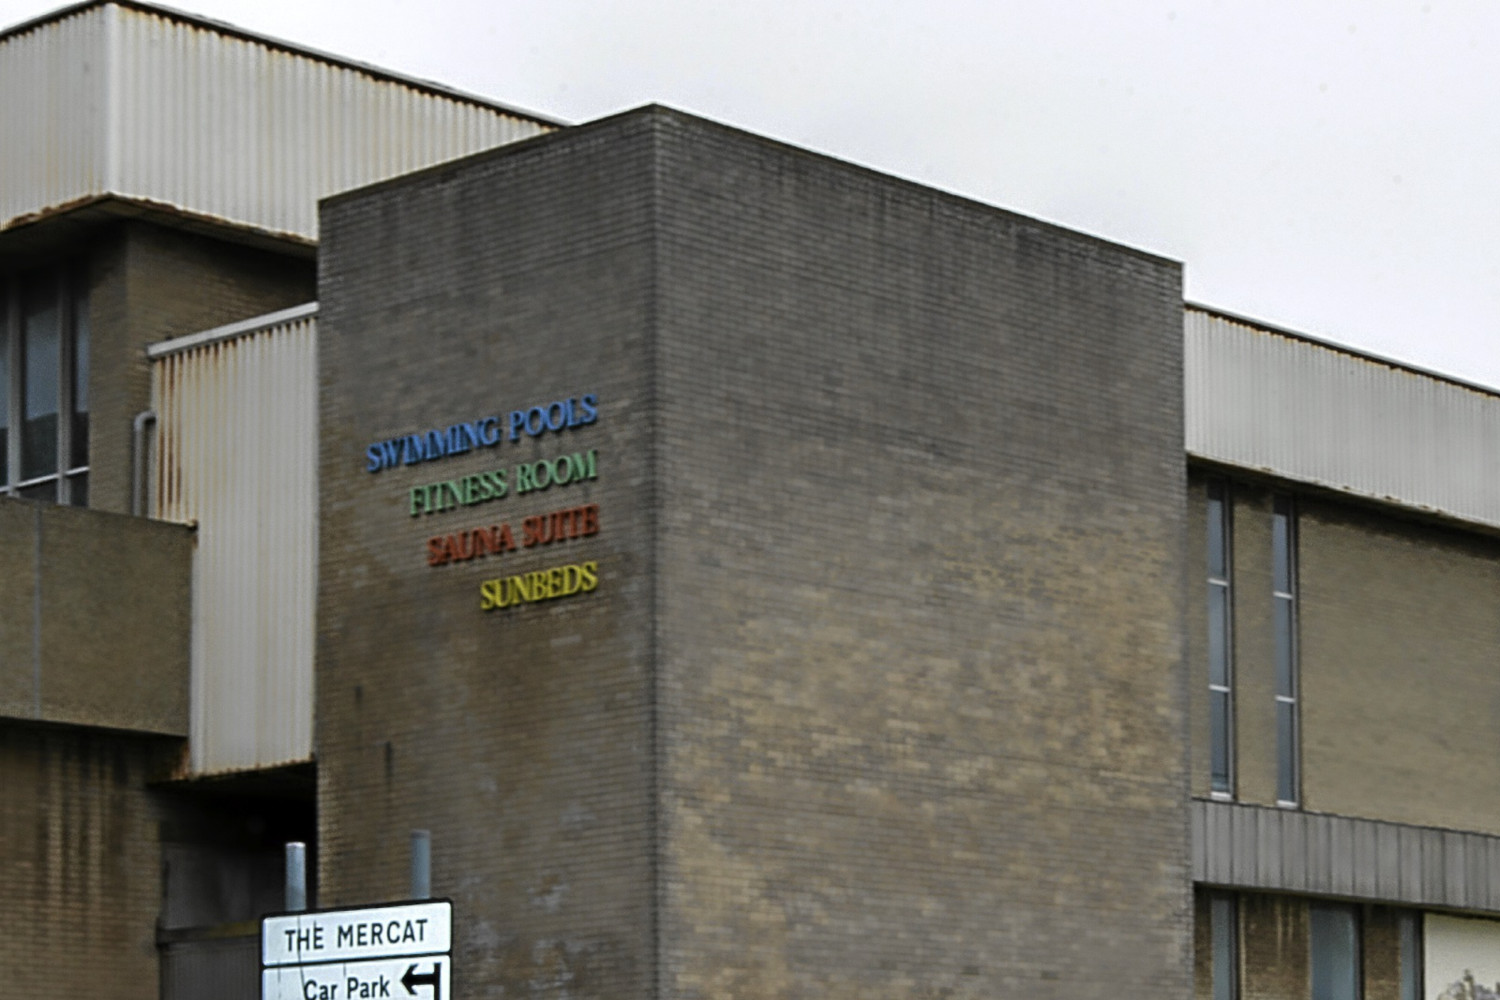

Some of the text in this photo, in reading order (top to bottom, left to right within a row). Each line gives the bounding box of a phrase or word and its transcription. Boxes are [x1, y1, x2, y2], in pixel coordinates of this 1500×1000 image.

[365, 393, 598, 473] SWIMMING POOLS
[409, 450, 598, 516] FITNESS ROOM
[427, 503, 598, 567] SAUNA SUITE
[480, 561, 598, 610] SUNBEDS
[285, 918, 428, 952] THE MERCAT
[347, 975, 390, 1000] Park
